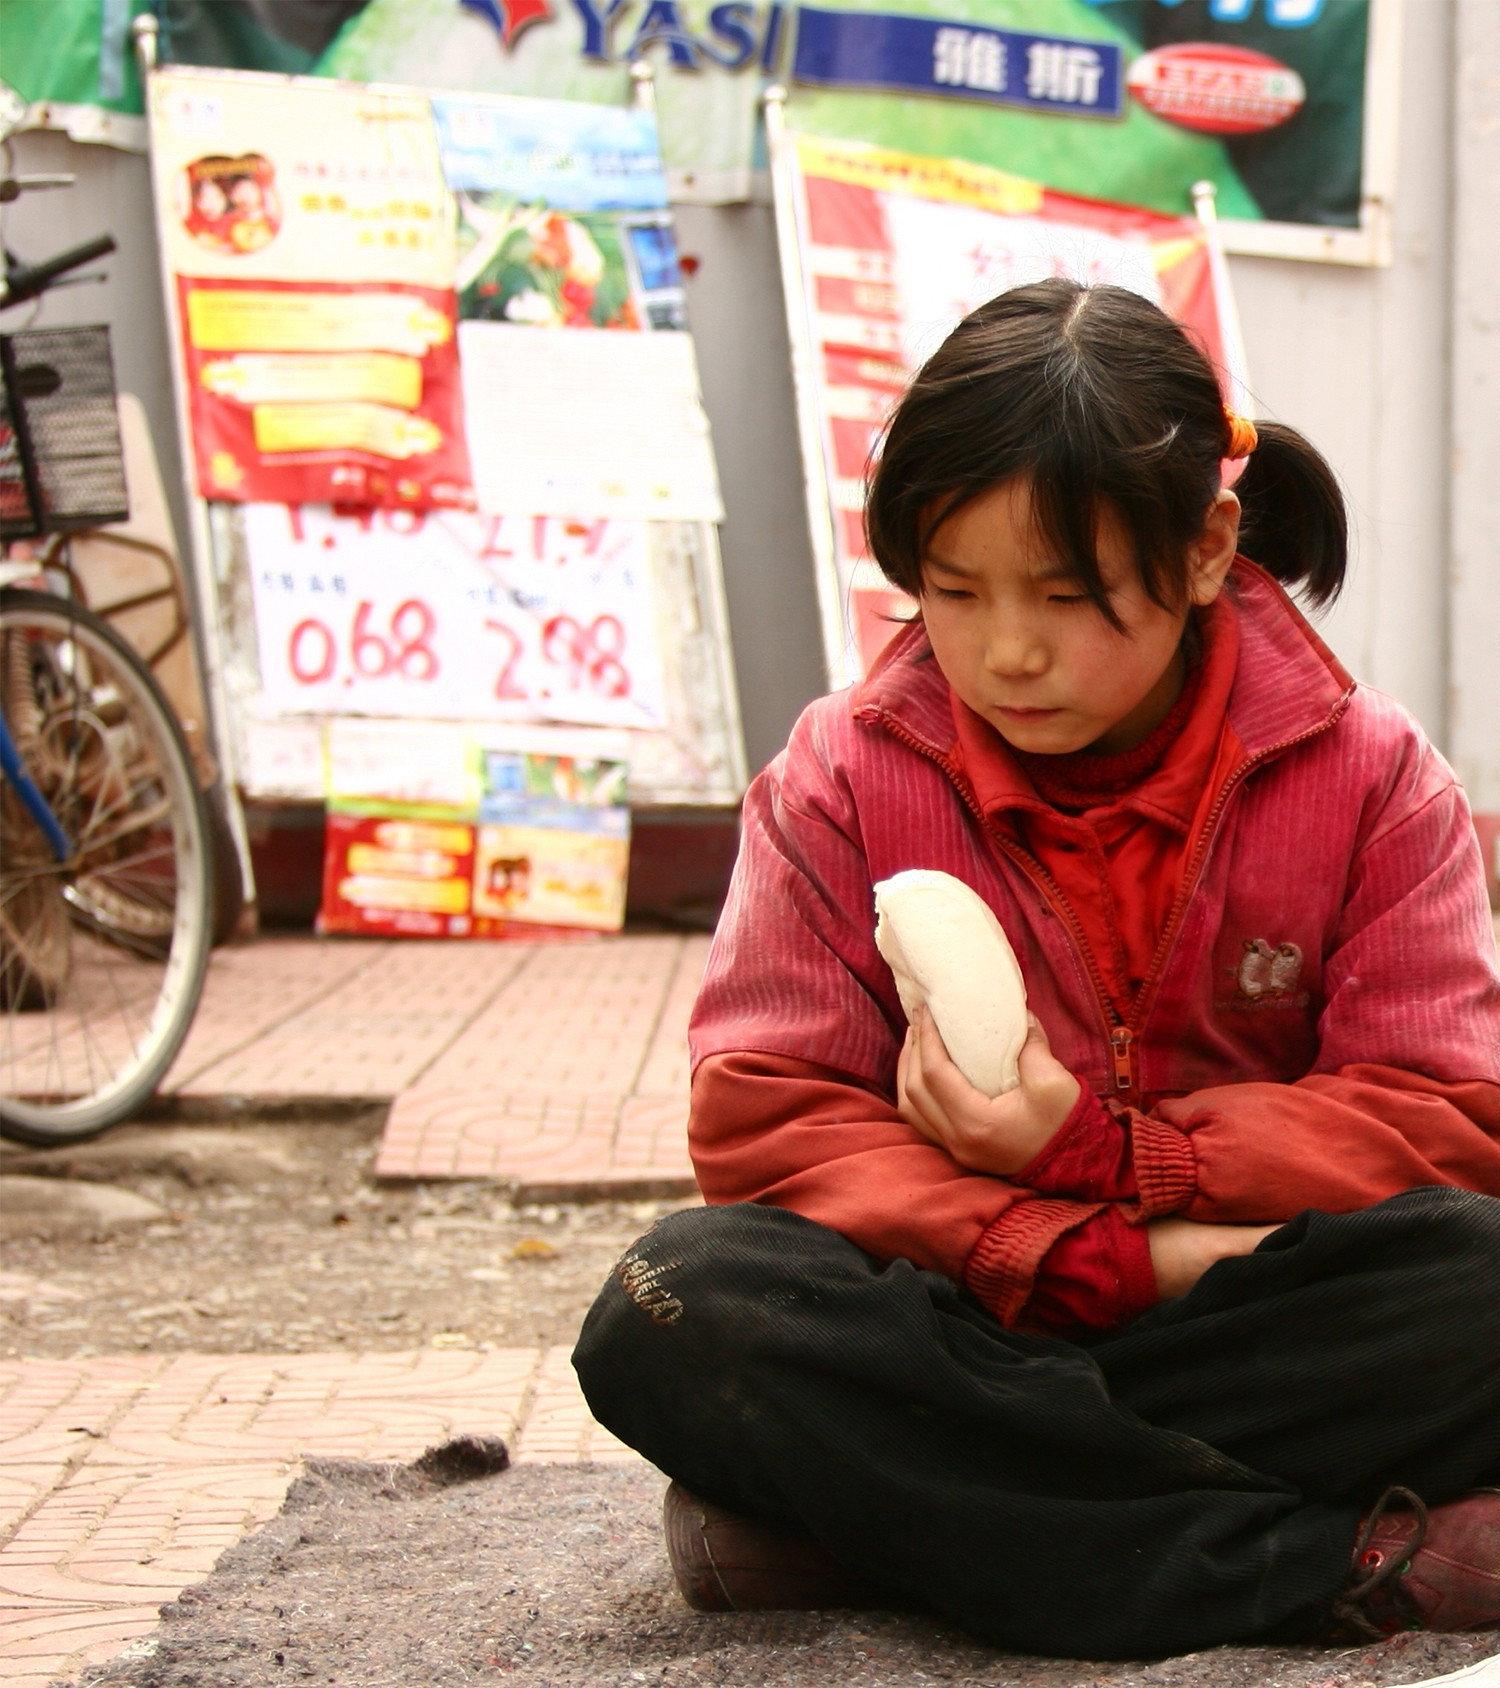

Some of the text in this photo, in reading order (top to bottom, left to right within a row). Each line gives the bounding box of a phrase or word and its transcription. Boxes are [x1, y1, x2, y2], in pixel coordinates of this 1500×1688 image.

[932, 26, 1103, 105] 雅斯
[288, 598, 440, 685] 0.68
[484, 613, 632, 701] 2.98
